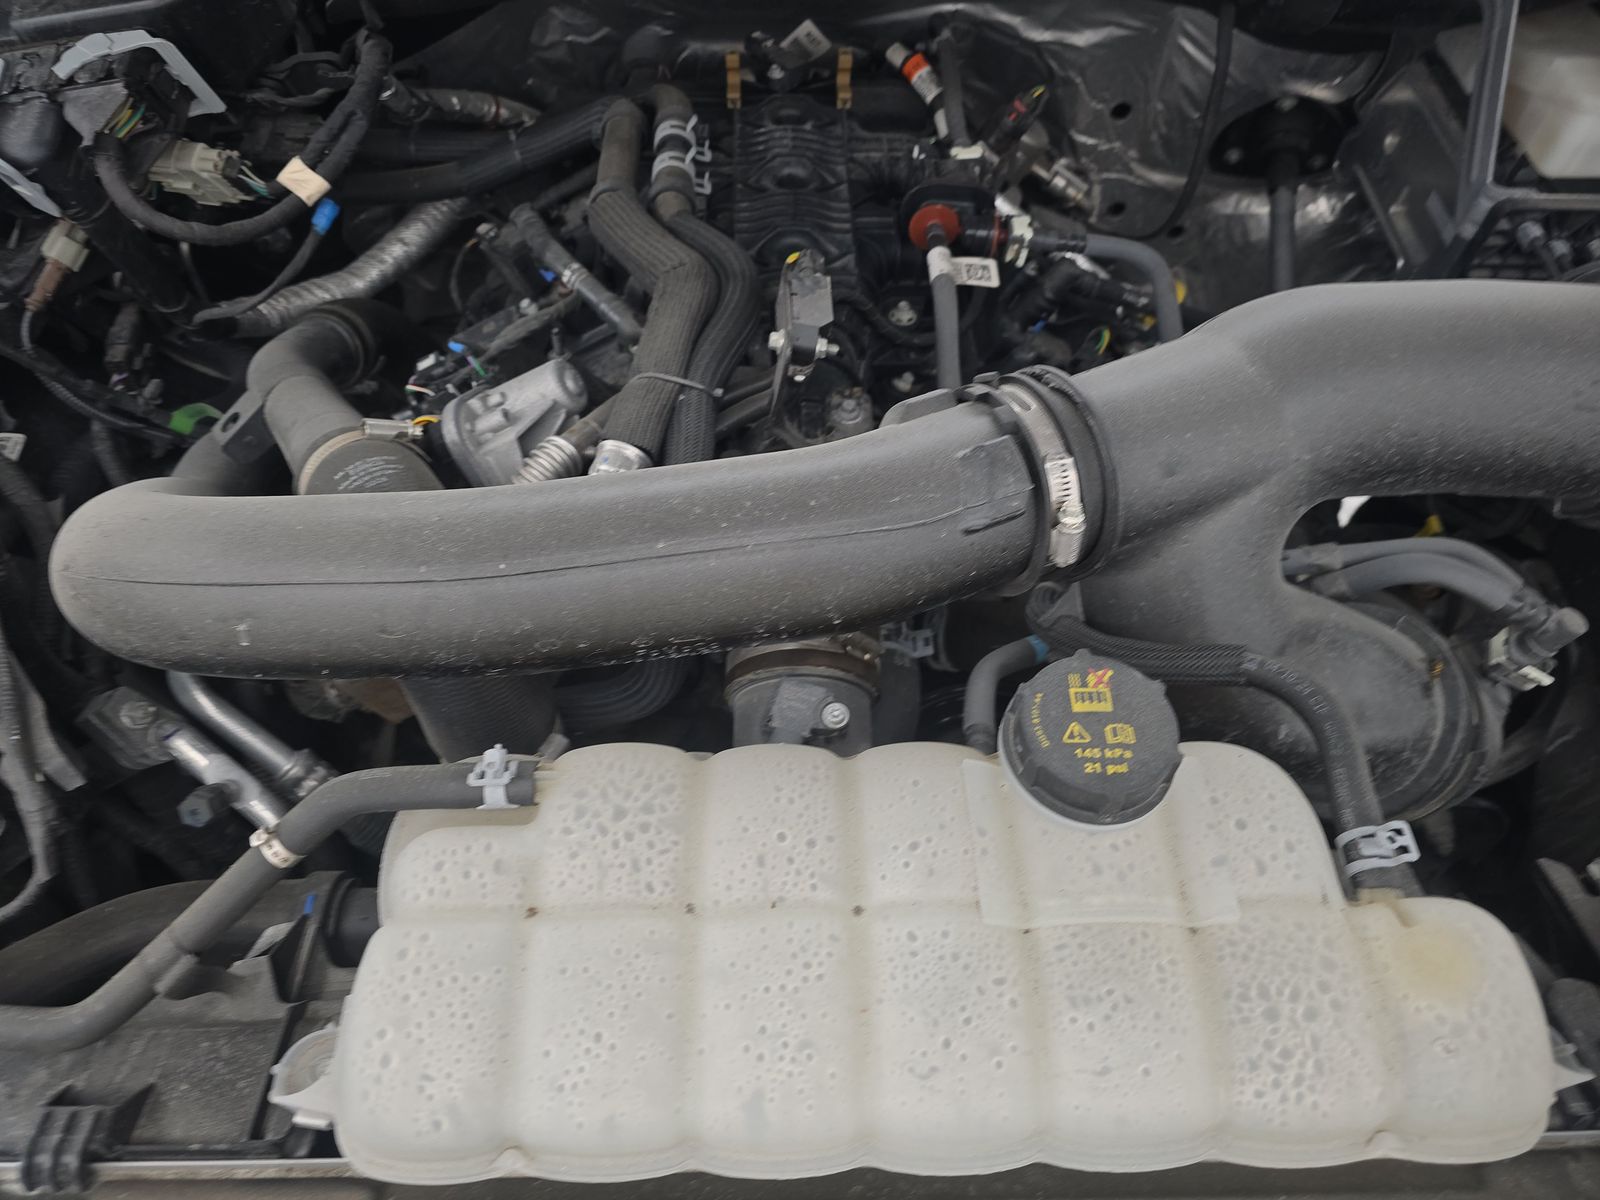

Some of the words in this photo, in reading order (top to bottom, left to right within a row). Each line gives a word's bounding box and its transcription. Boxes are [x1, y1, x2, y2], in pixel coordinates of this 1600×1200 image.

[1074, 748, 1102, 758] 145
[1104, 748, 1134, 759] kPa
[1084, 762, 1102, 774] 21
[1105, 762, 1129, 776] psi
